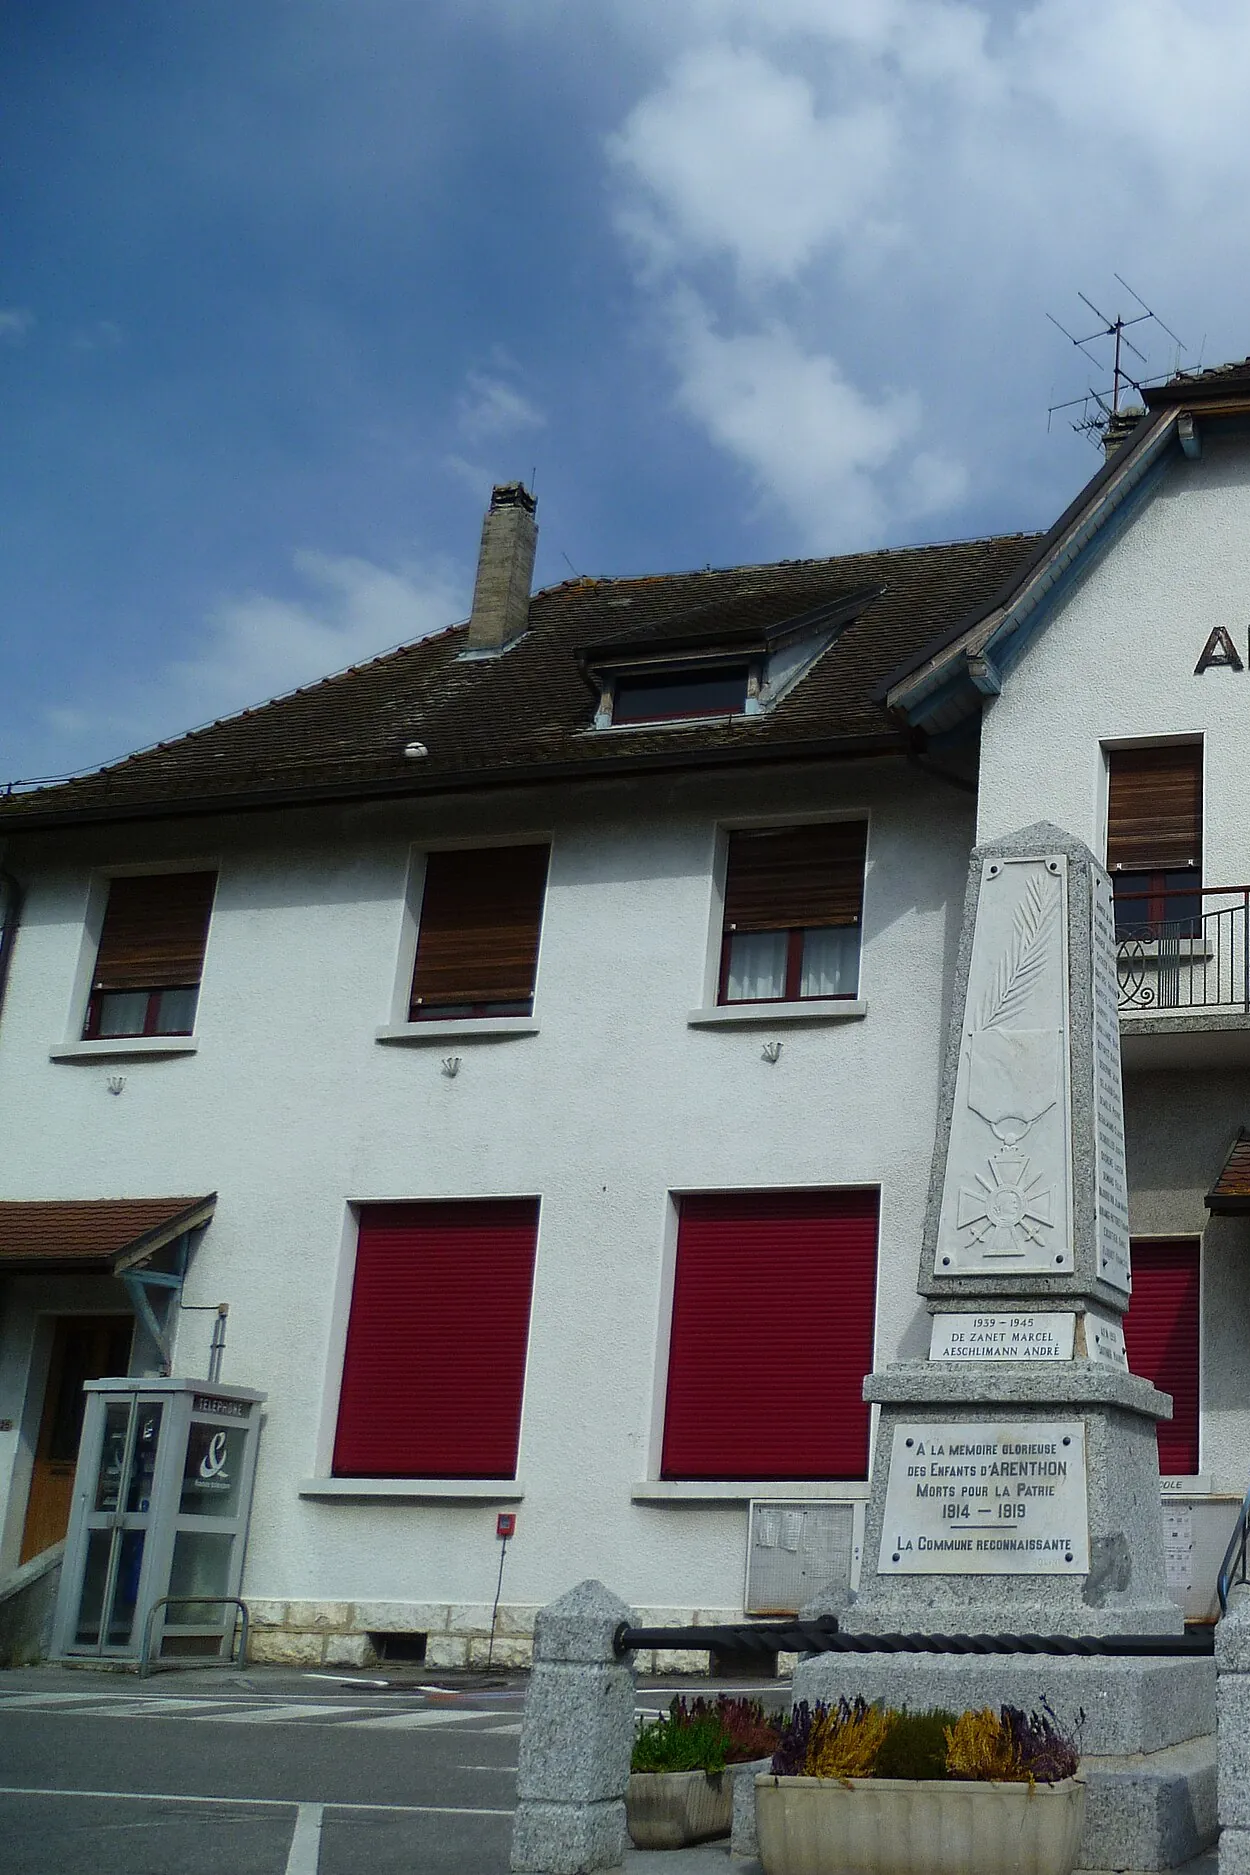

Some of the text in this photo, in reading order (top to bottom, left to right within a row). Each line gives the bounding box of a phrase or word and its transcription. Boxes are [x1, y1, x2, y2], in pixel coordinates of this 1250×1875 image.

[973, 1318, 996, 1328] 1939
[1010, 1318, 1034, 1328] 1945
[951, 1331, 1054, 1342] DE ZANET MARCEL
[943, 1343, 1060, 1356] AESCHLIMANN ANDRÉ
[916, 1442, 1057, 1456] A LA MEMOIRE GLORIEUSE
[907, 1461, 1067, 1477] DES ENFANTS D'ARENTHON
[916, 1482, 1055, 1497] MORTS POUR LA PATRIE
[942, 1503, 970, 1519] 1914
[998, 1503, 1026, 1518] 1919
[897, 1536, 1071, 1551] LA COMMUNE RECONNAISSANTE
